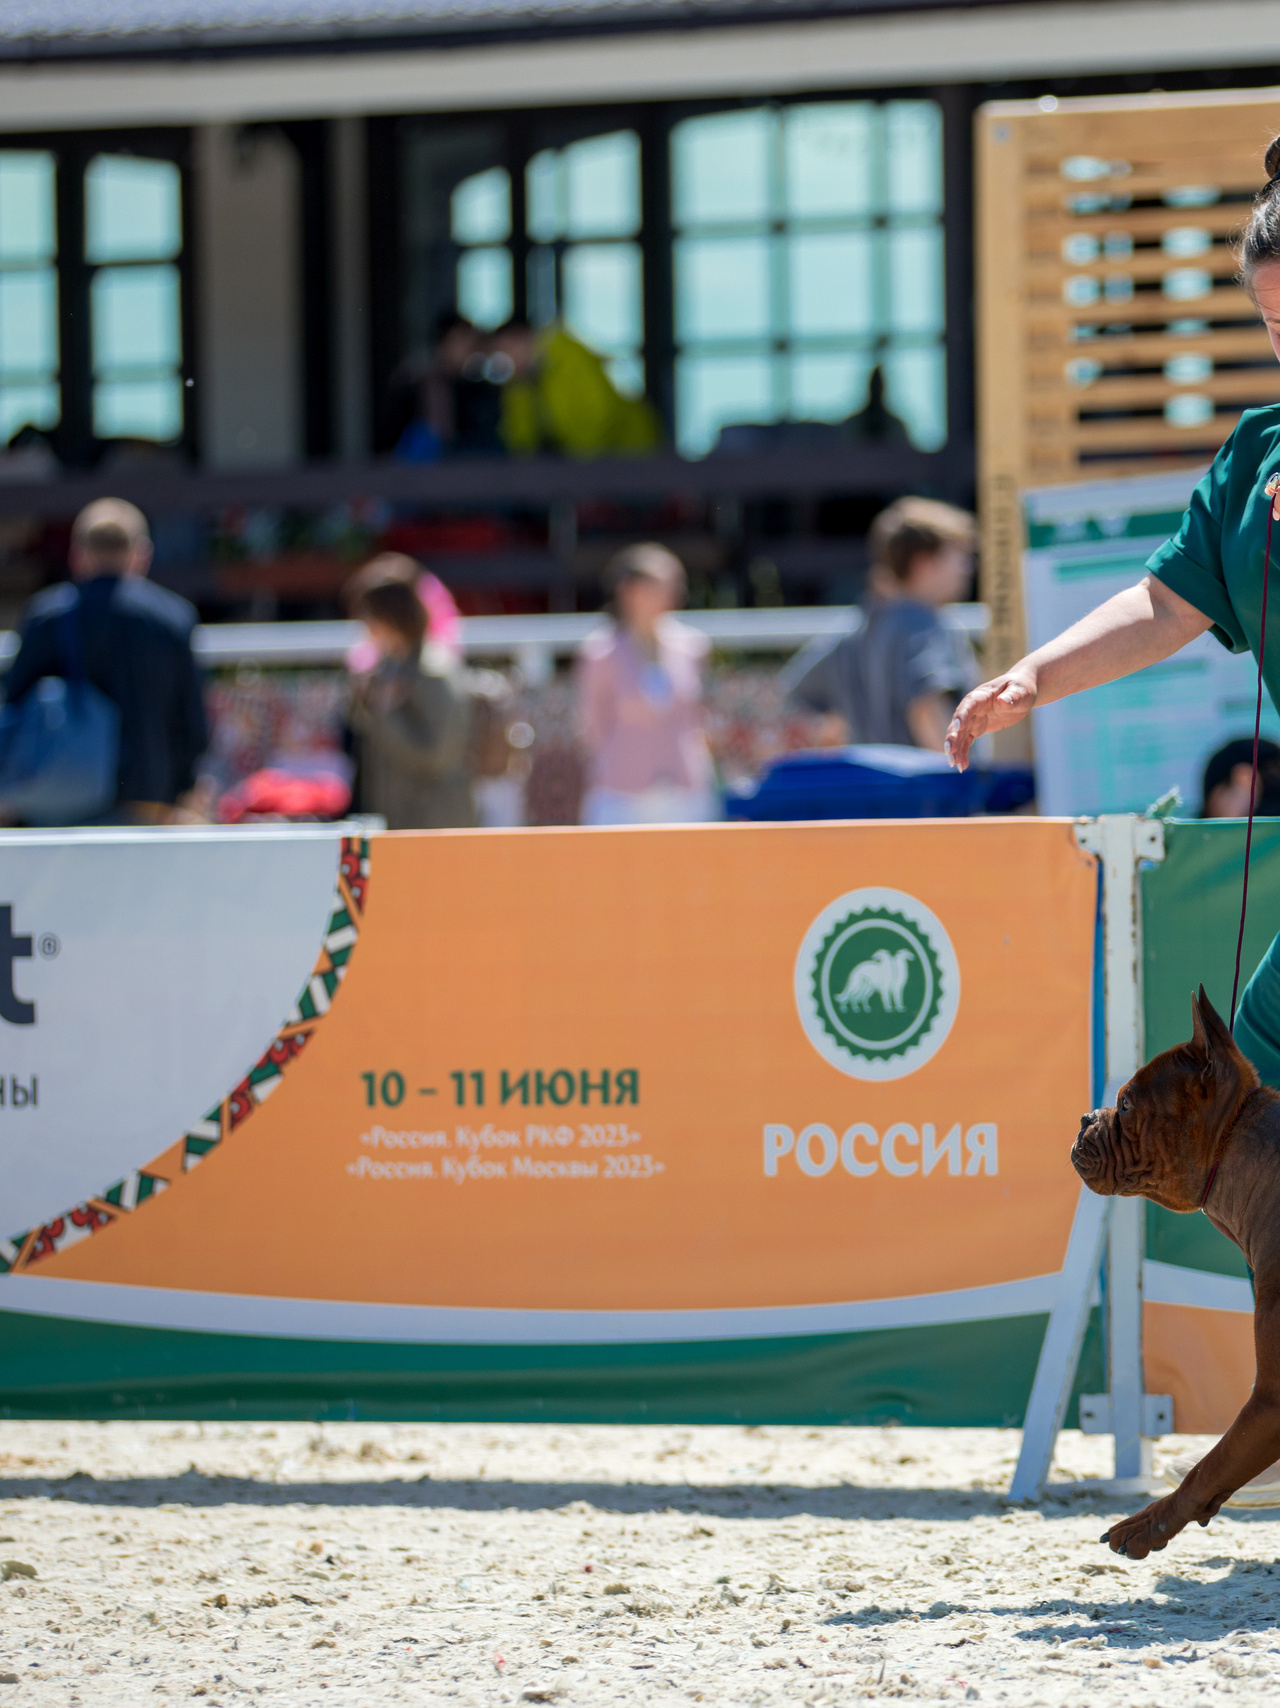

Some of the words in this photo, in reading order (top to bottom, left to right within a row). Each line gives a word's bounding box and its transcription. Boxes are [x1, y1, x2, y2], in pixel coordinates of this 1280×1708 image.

[361, 1070, 406, 1107] 10
[451, 1070, 485, 1106] 11
[500, 1069, 639, 1107] ИЮНЯ
[455, 1123, 523, 1153] Кубок
[525, 1124, 575, 1148] РКФ
[763, 1122, 998, 1178] РОССИЯ
[441, 1154, 508, 1186] Кубок
[512, 1155, 598, 1179] Москвы
